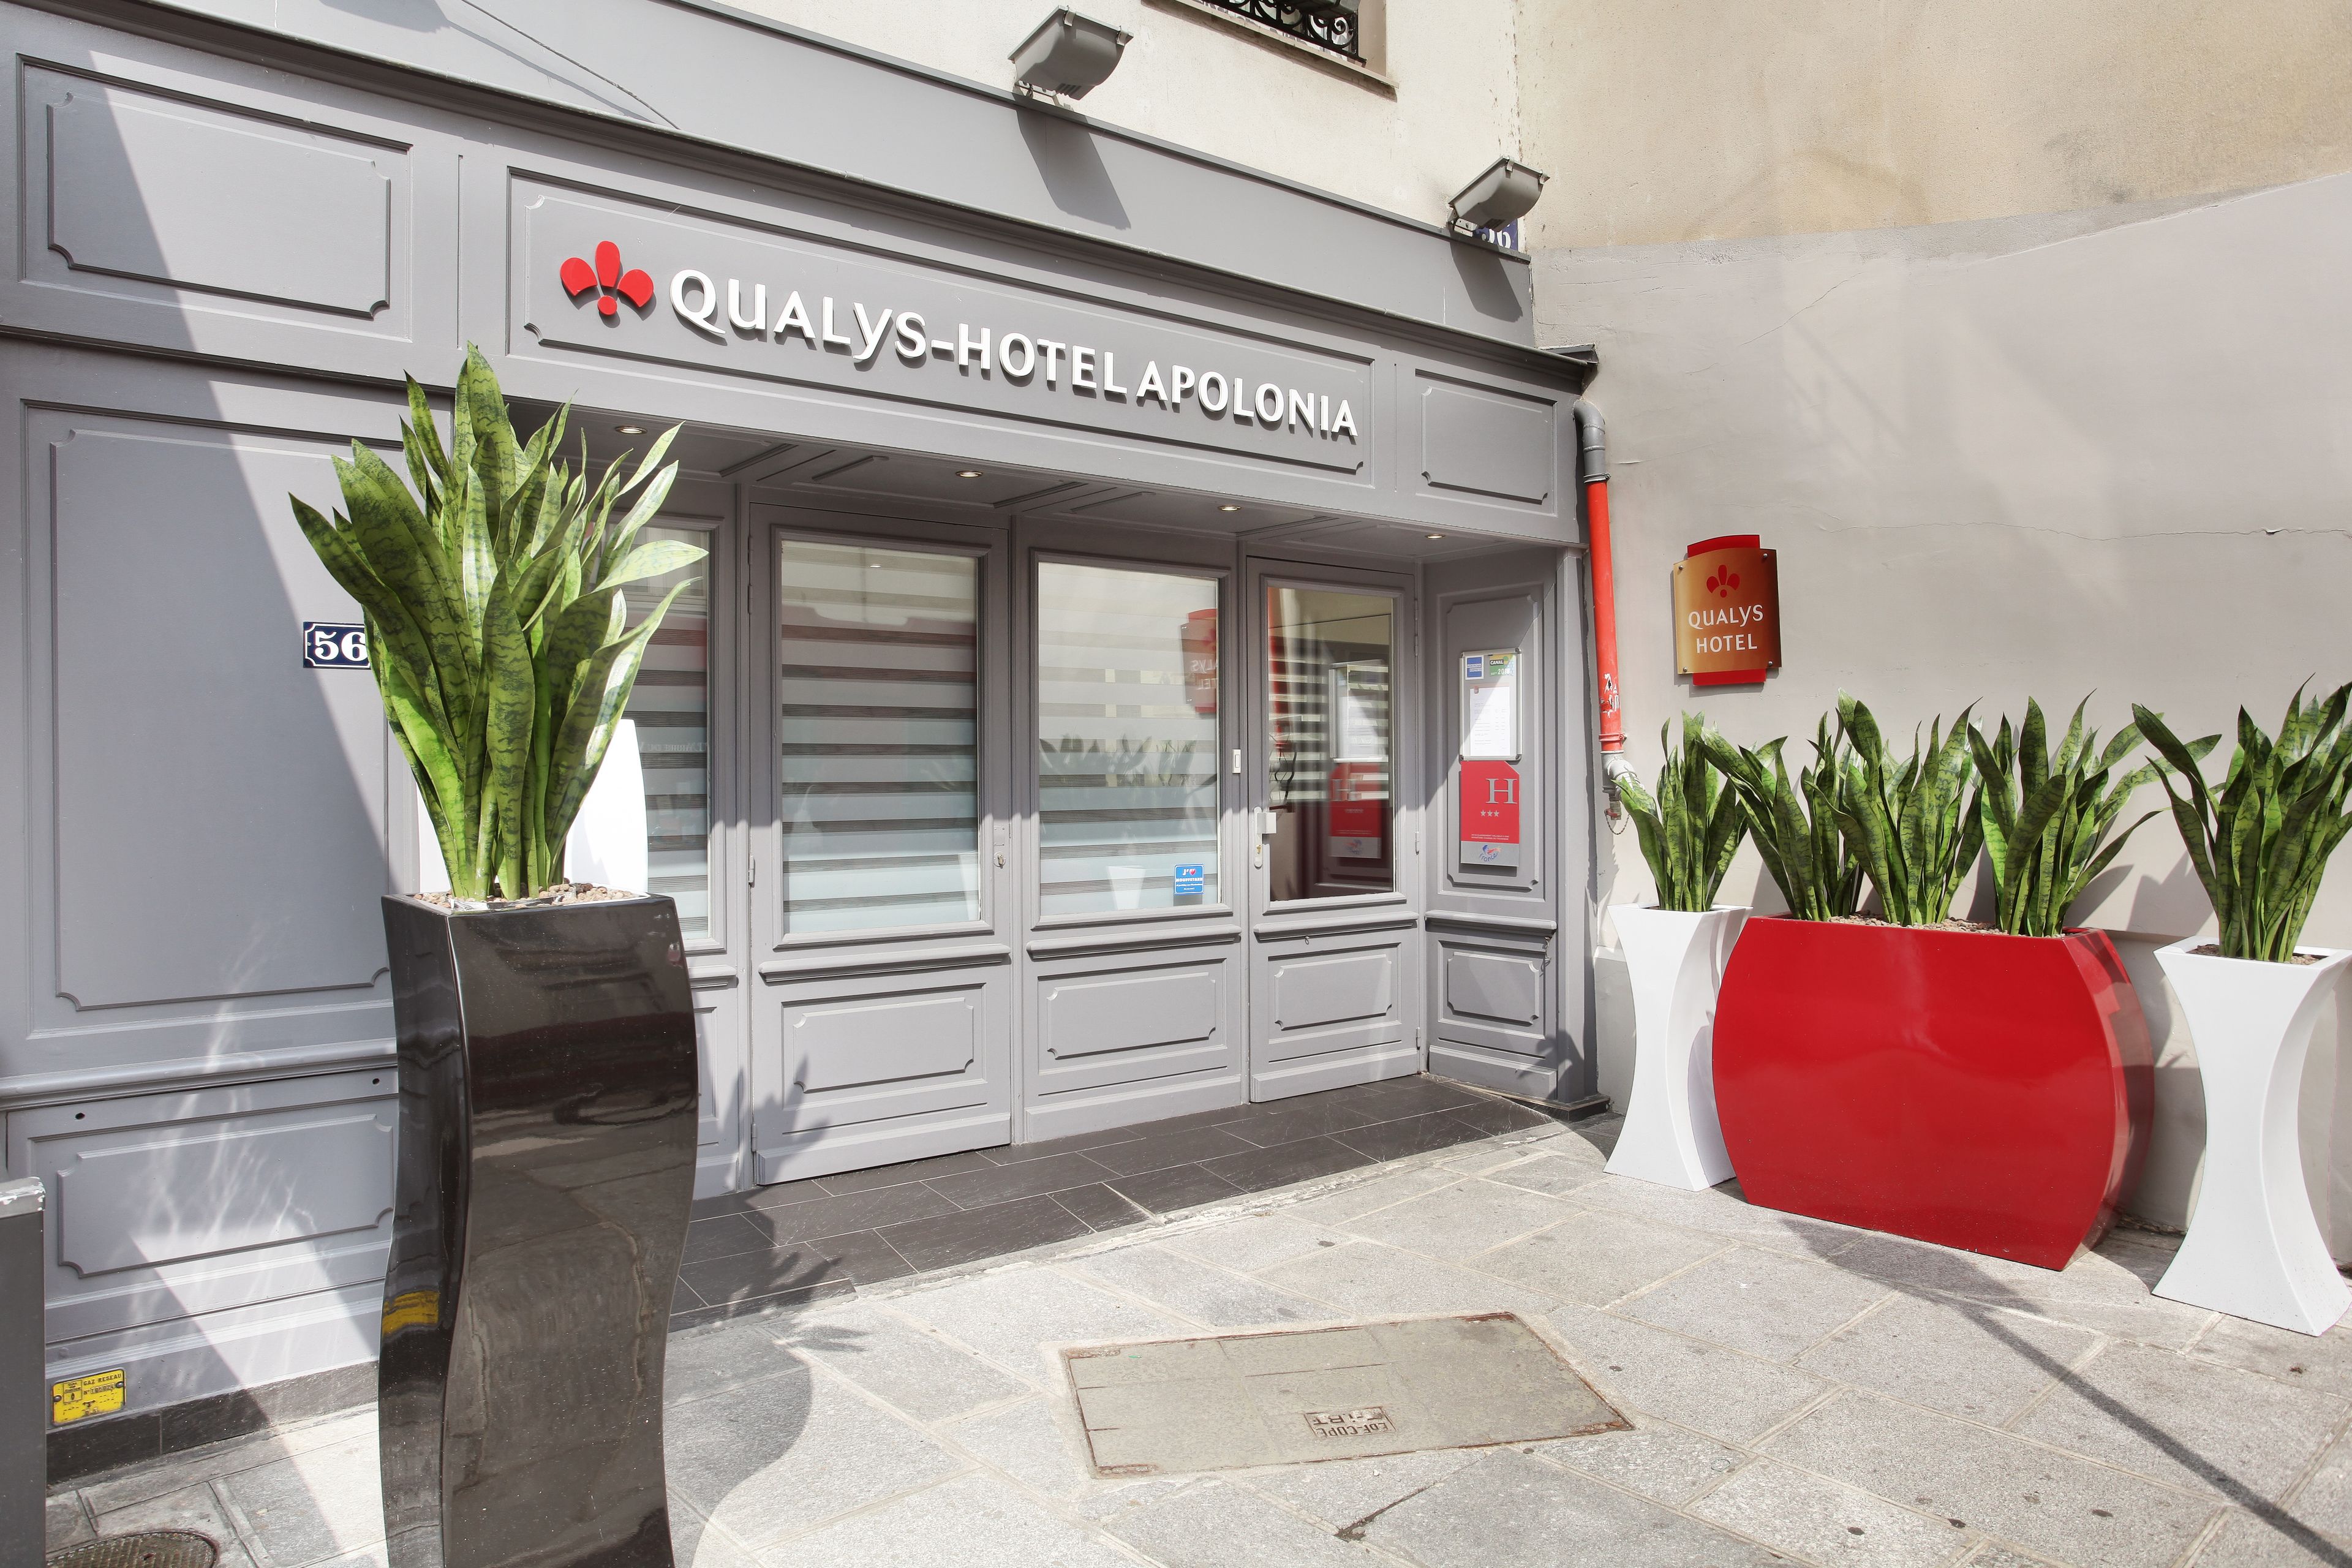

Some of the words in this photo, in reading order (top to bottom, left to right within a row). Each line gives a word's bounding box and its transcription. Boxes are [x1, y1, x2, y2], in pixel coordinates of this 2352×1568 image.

[1136, 360, 1359, 437] APOLONIA
[1688, 604, 1764, 630] QUALYS
[314, 630, 368, 662] 56
[1696, 633, 1757, 654] HOTEL
[1485, 778, 1518, 804] H
[98, 1373, 121, 1382] RESEAU
